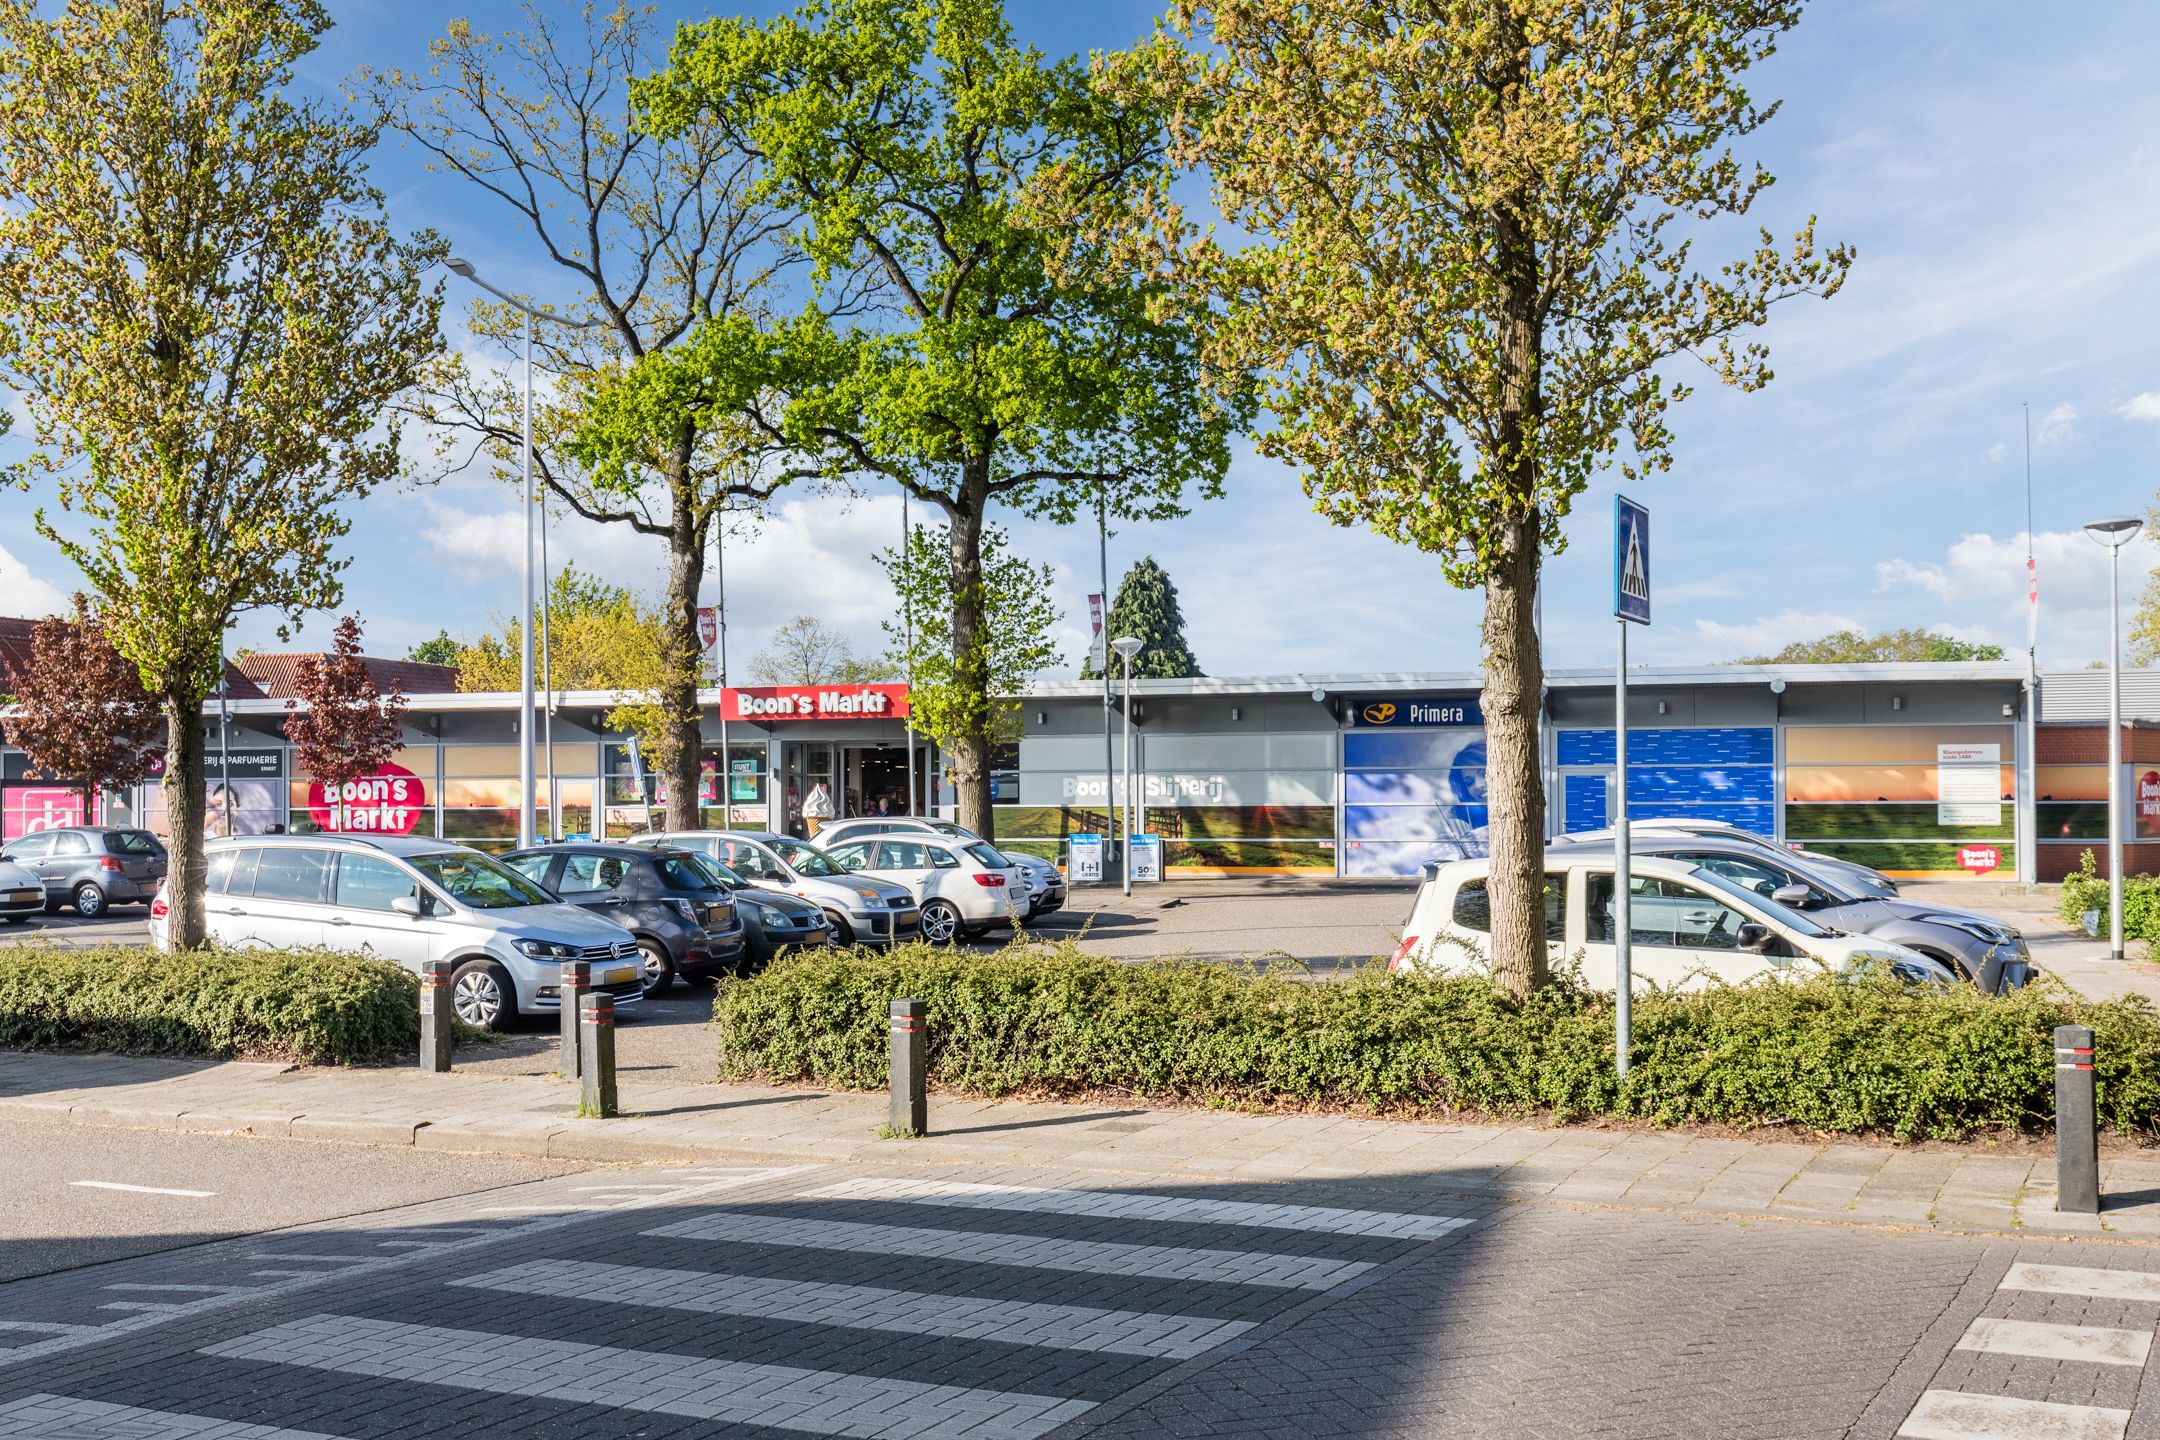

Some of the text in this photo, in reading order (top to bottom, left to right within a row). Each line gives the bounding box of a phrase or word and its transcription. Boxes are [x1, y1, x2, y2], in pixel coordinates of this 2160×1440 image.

[737, 689, 887, 716] Boon's Markt
[1410, 704, 1464, 722] Primera
[204, 756, 218, 767] ERIJ
[227, 755, 277, 765] PARFUMERIE
[324, 775, 408, 803] Boon's
[1146, 776, 1223, 803] Slijterij
[2142, 780, 2160, 798] Boon'
[2144, 797, 2160, 815] Mark
[329, 802, 407, 830] Markt
[1137, 866, 1156, 874] 50%
